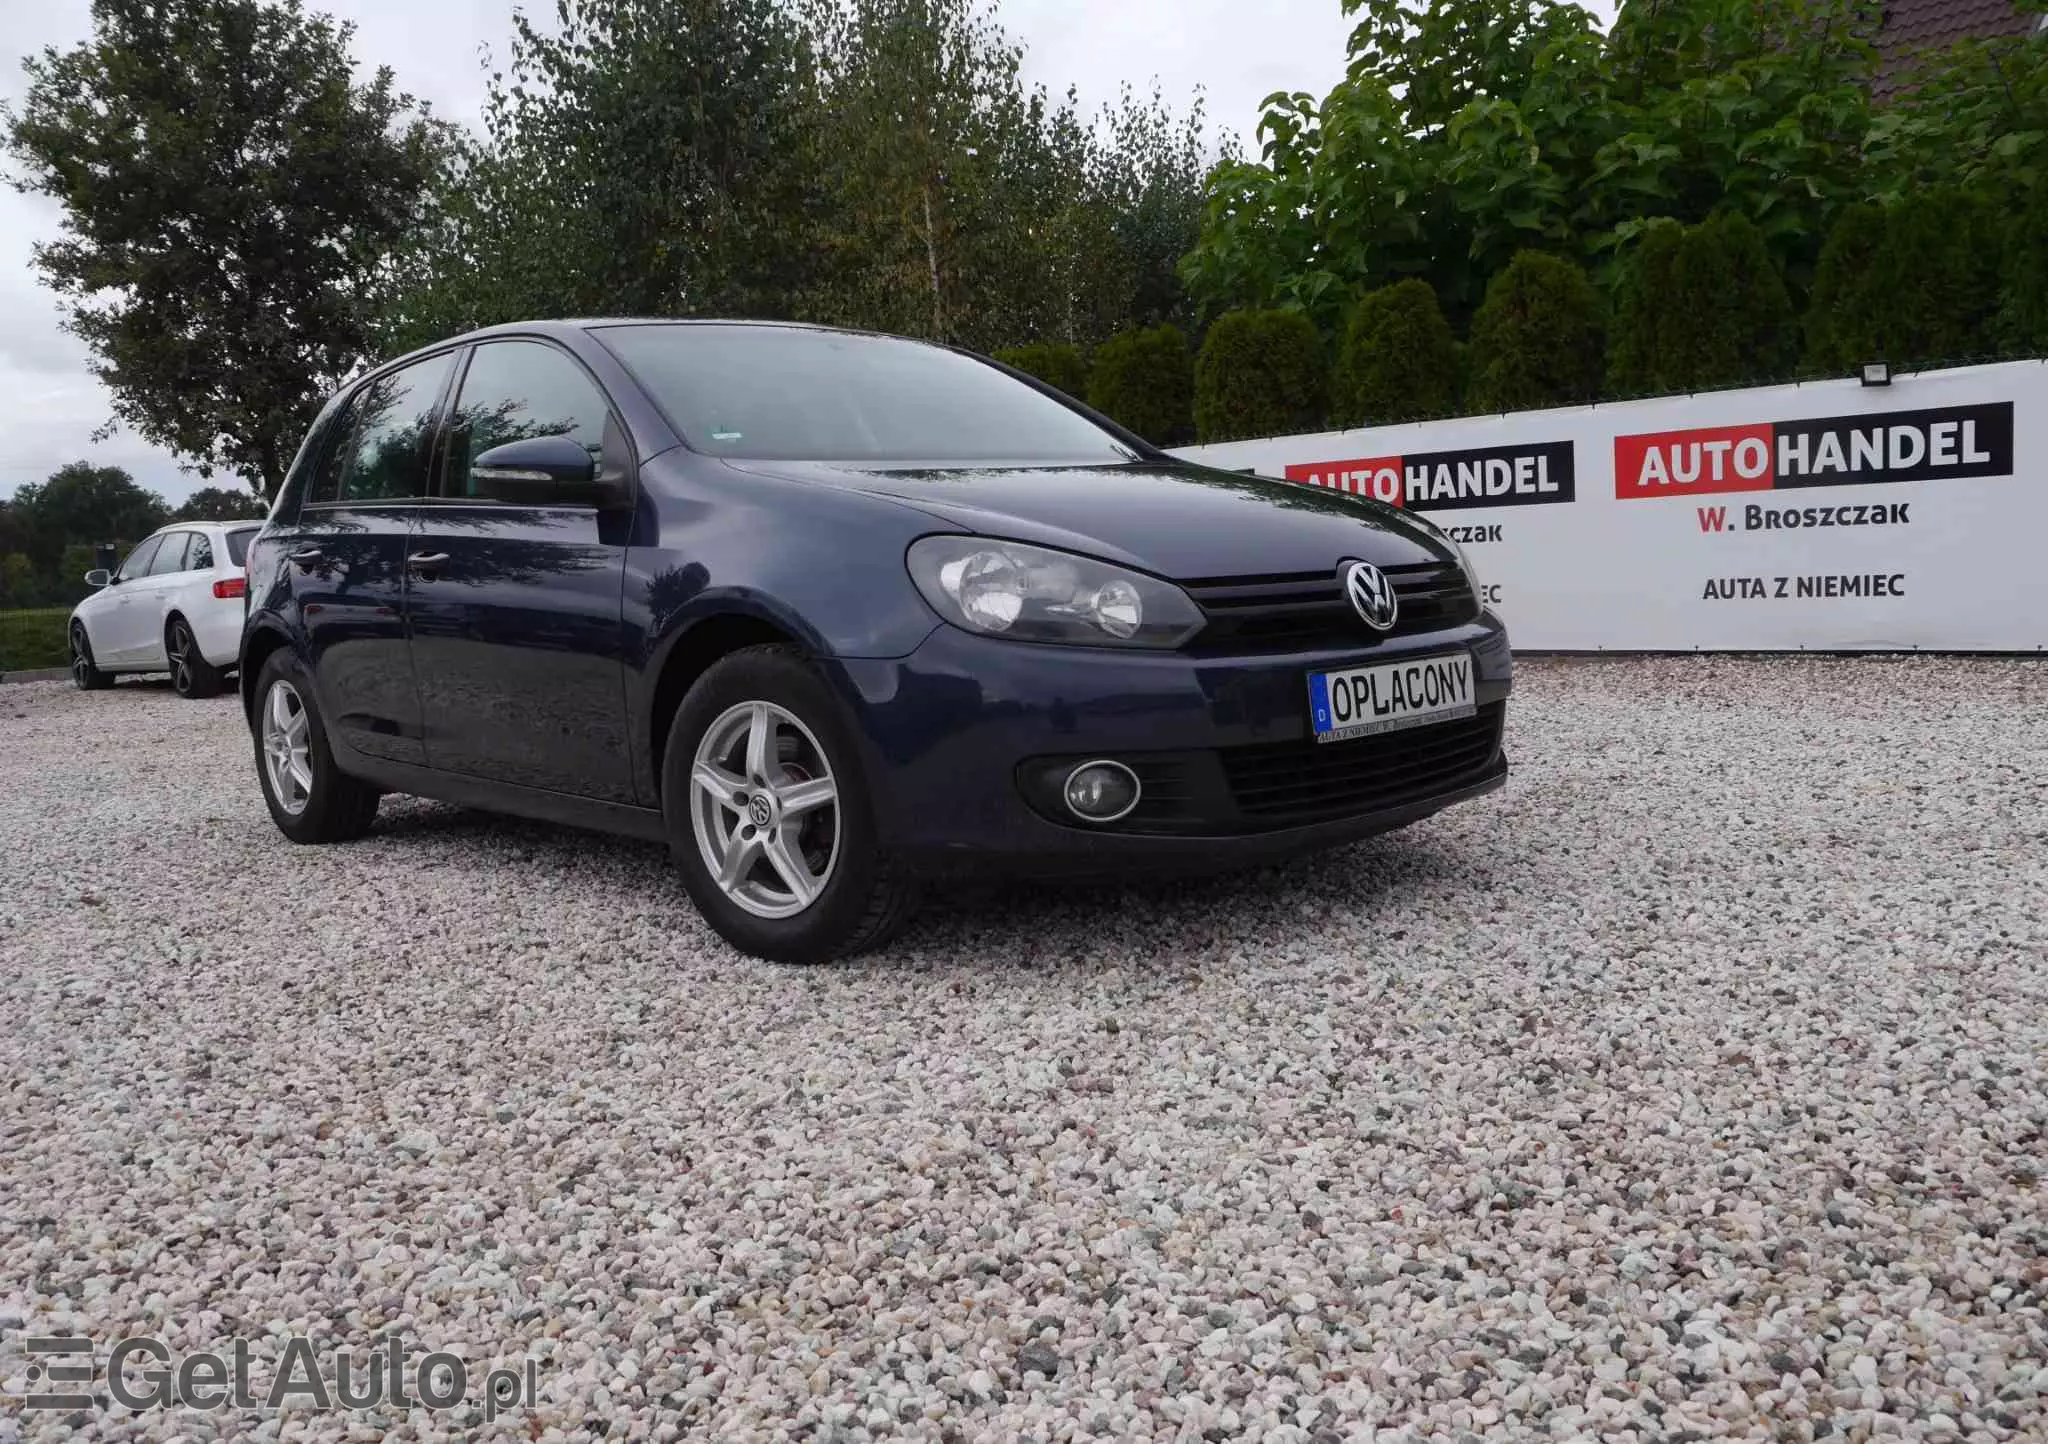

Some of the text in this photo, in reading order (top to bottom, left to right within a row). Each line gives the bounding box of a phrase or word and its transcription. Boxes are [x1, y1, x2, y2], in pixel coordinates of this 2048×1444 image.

[1637, 419, 1991, 487] AUTOHANDEL
[1697, 505, 1736, 533] W.
[1702, 574, 1905, 601] AUTA Z NIEMIEC
[1332, 660, 1468, 722] OPLACONY
